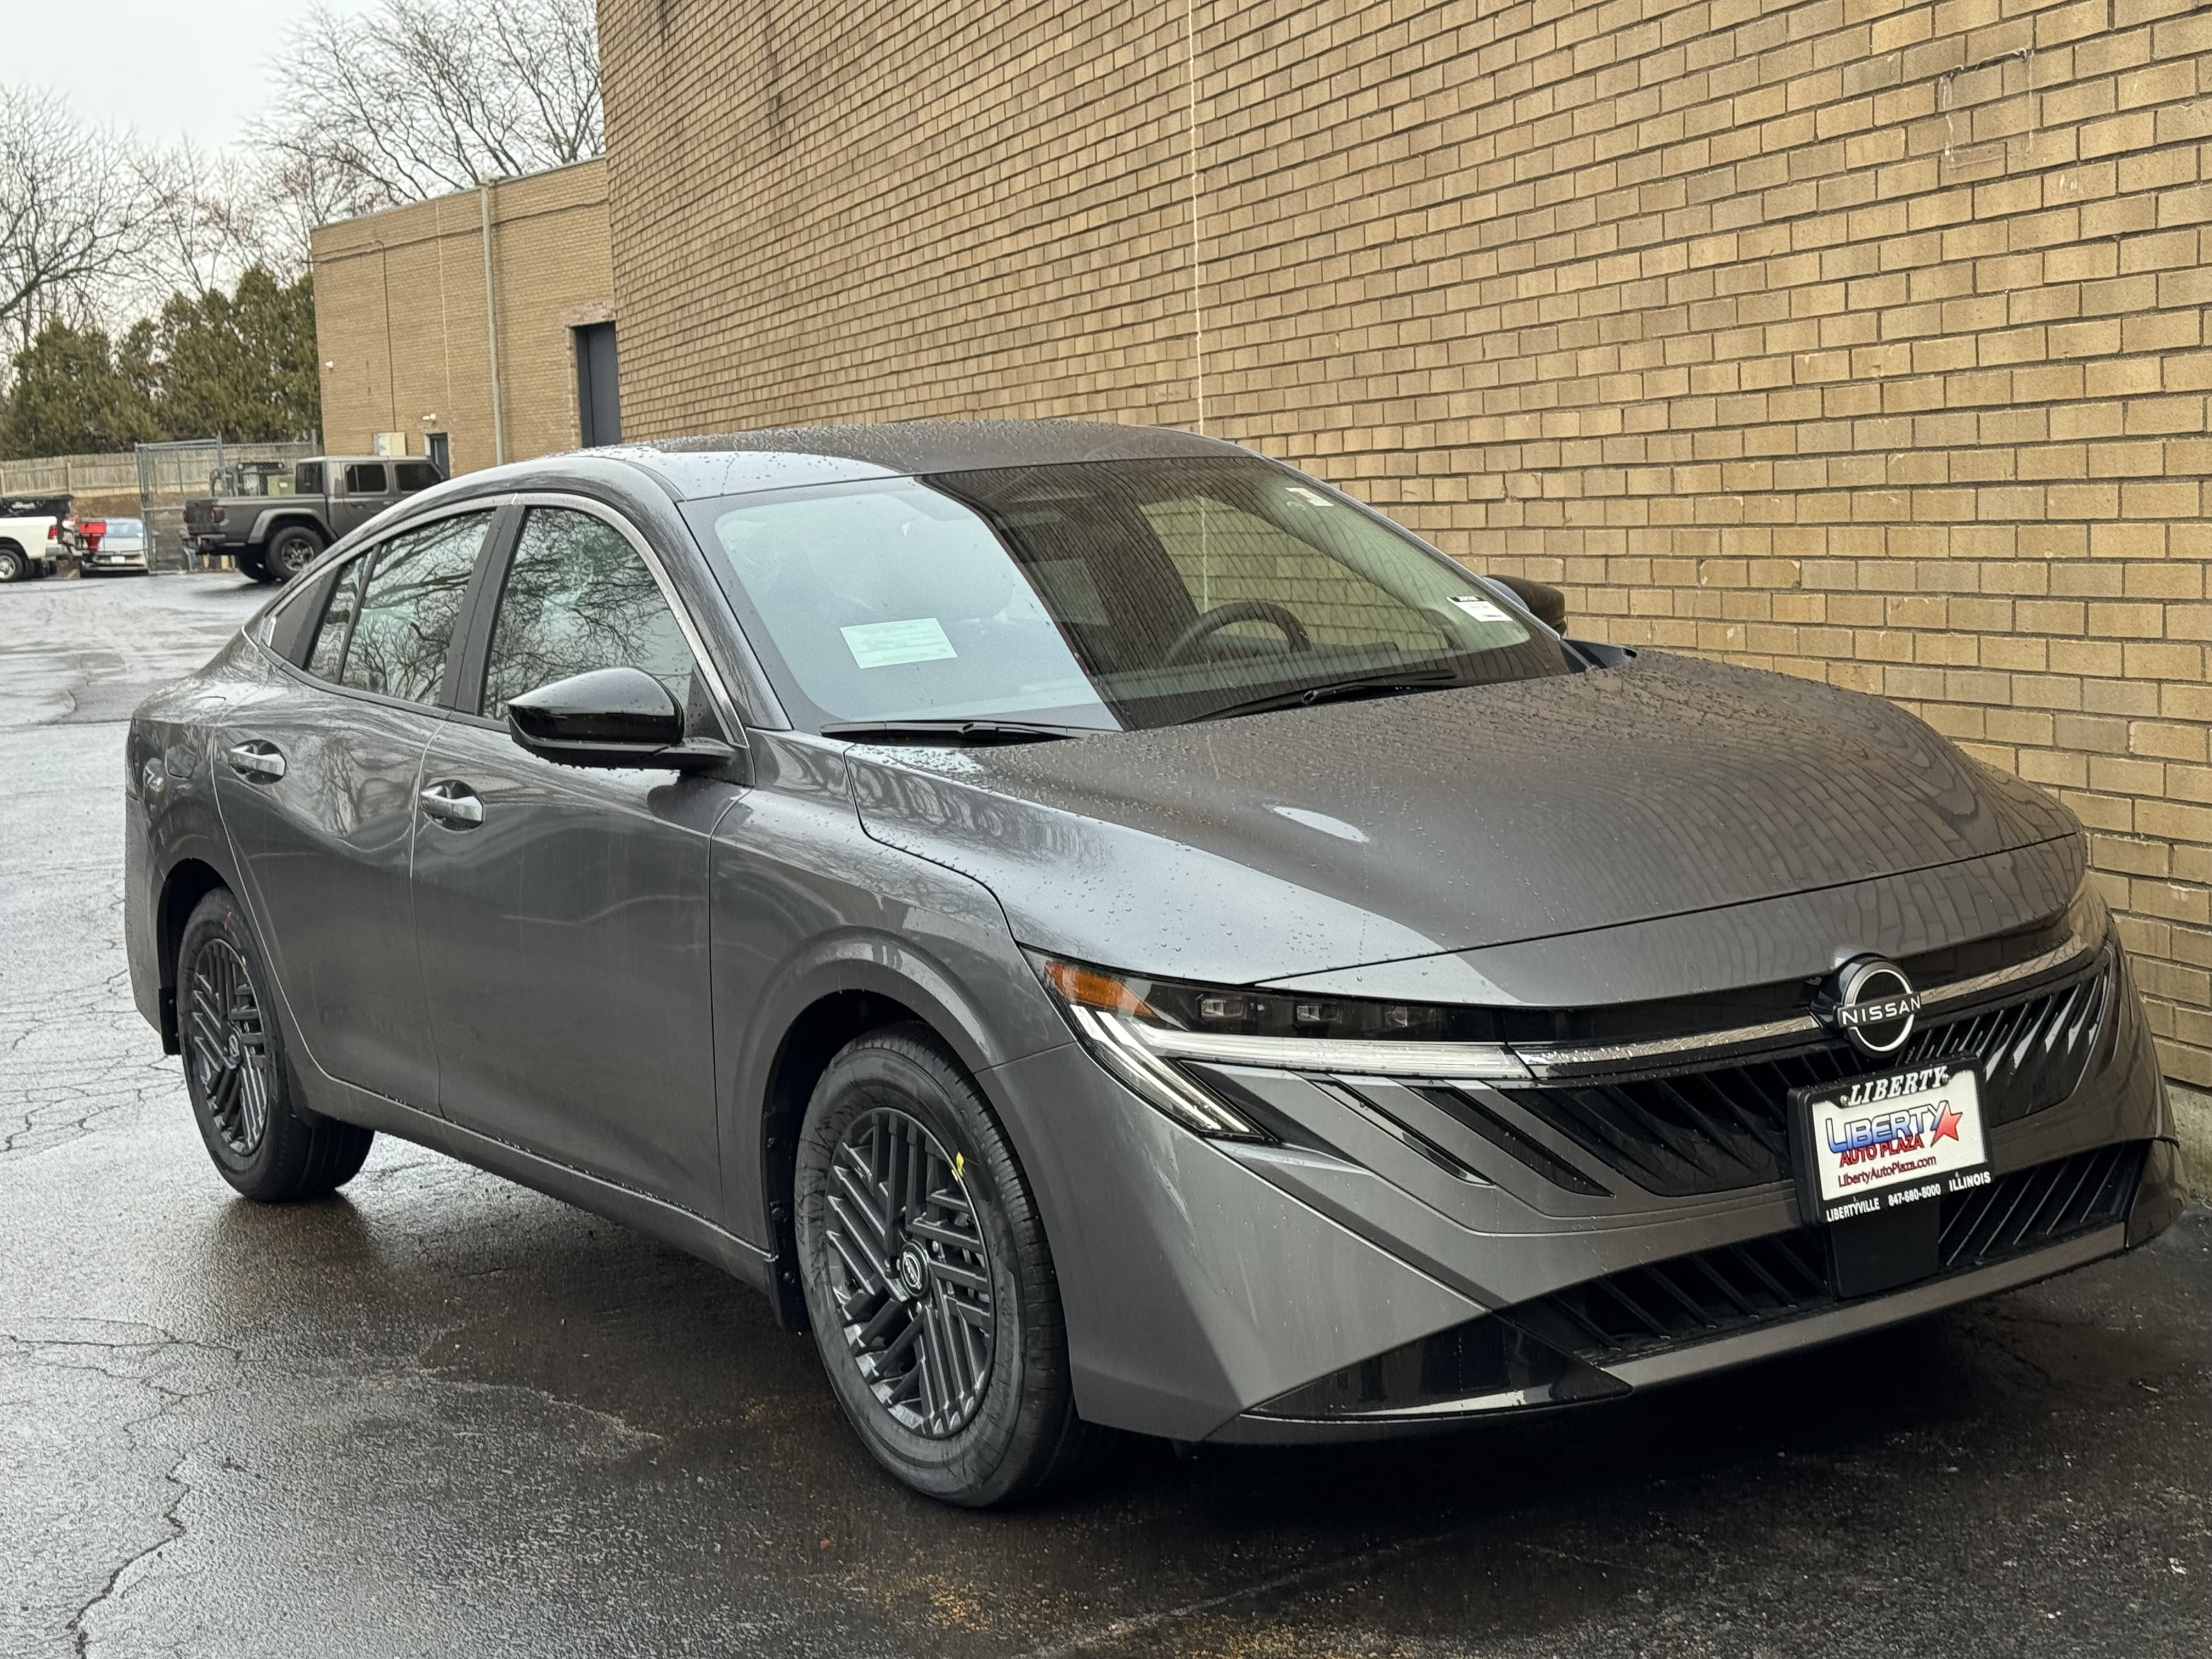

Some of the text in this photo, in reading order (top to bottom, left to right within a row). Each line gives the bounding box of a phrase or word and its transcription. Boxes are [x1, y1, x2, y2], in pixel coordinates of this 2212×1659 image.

[1842, 995, 1921, 1025] NISSAN
[1848, 1065, 1948, 1107] LIBERTY
[1825, 1100, 1949, 1153] LIBERTY
[1839, 1134, 1925, 1167] AUTO PLAZA
[1838, 1156, 1937, 1187] LibertyAutoPlaza.com
[1826, 1171, 1991, 1222] LIBERTYVILLE 847-680-8000 ILLINOIS
